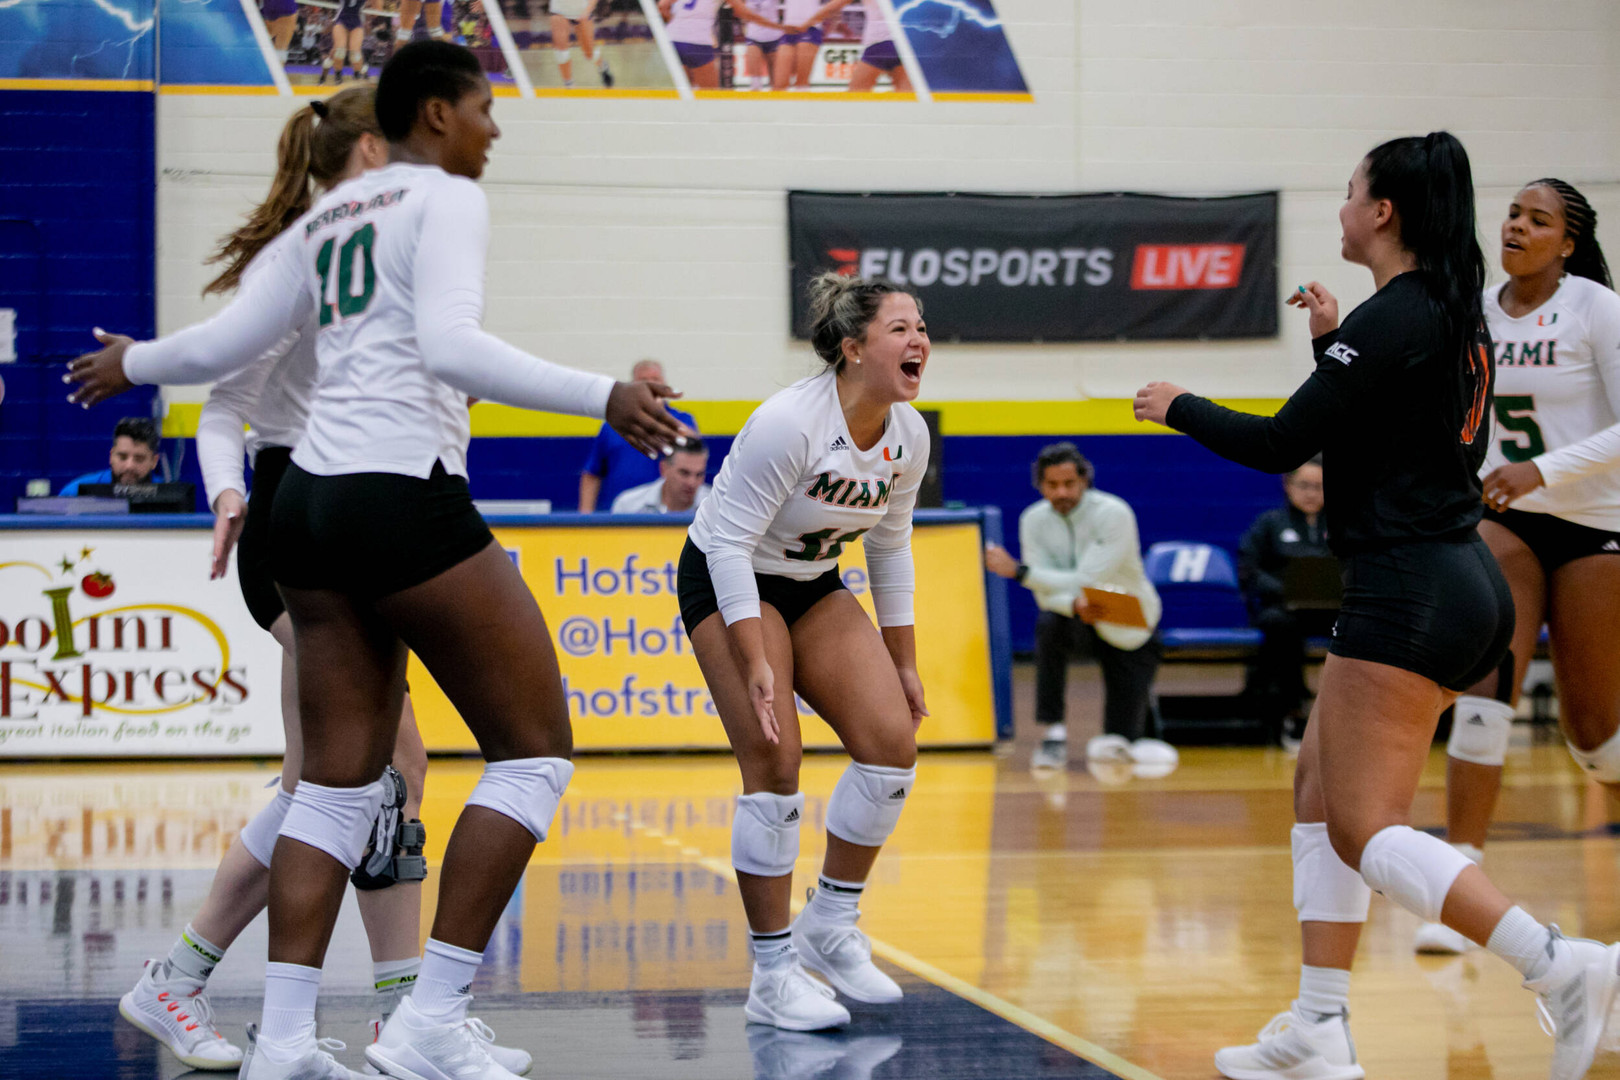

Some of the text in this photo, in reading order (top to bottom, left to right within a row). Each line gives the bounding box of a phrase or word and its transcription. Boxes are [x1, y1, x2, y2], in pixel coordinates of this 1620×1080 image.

[316, 223, 377, 327] 10
[859, 246, 1233, 287] FLOSPORTS LIVE
[1324, 341, 1359, 365] ACC
[1493, 393, 1549, 464] 5
[804, 472, 903, 509] MIAM
[555, 553, 678, 596] Hofst
[1170, 545, 1213, 583] H
[558, 614, 693, 658] @Hof
[0, 658, 249, 720] Express
[51, 720, 108, 738] italian
[166, 726, 188, 737] on
[194, 720, 223, 737] the
[226, 725, 251, 744] go
